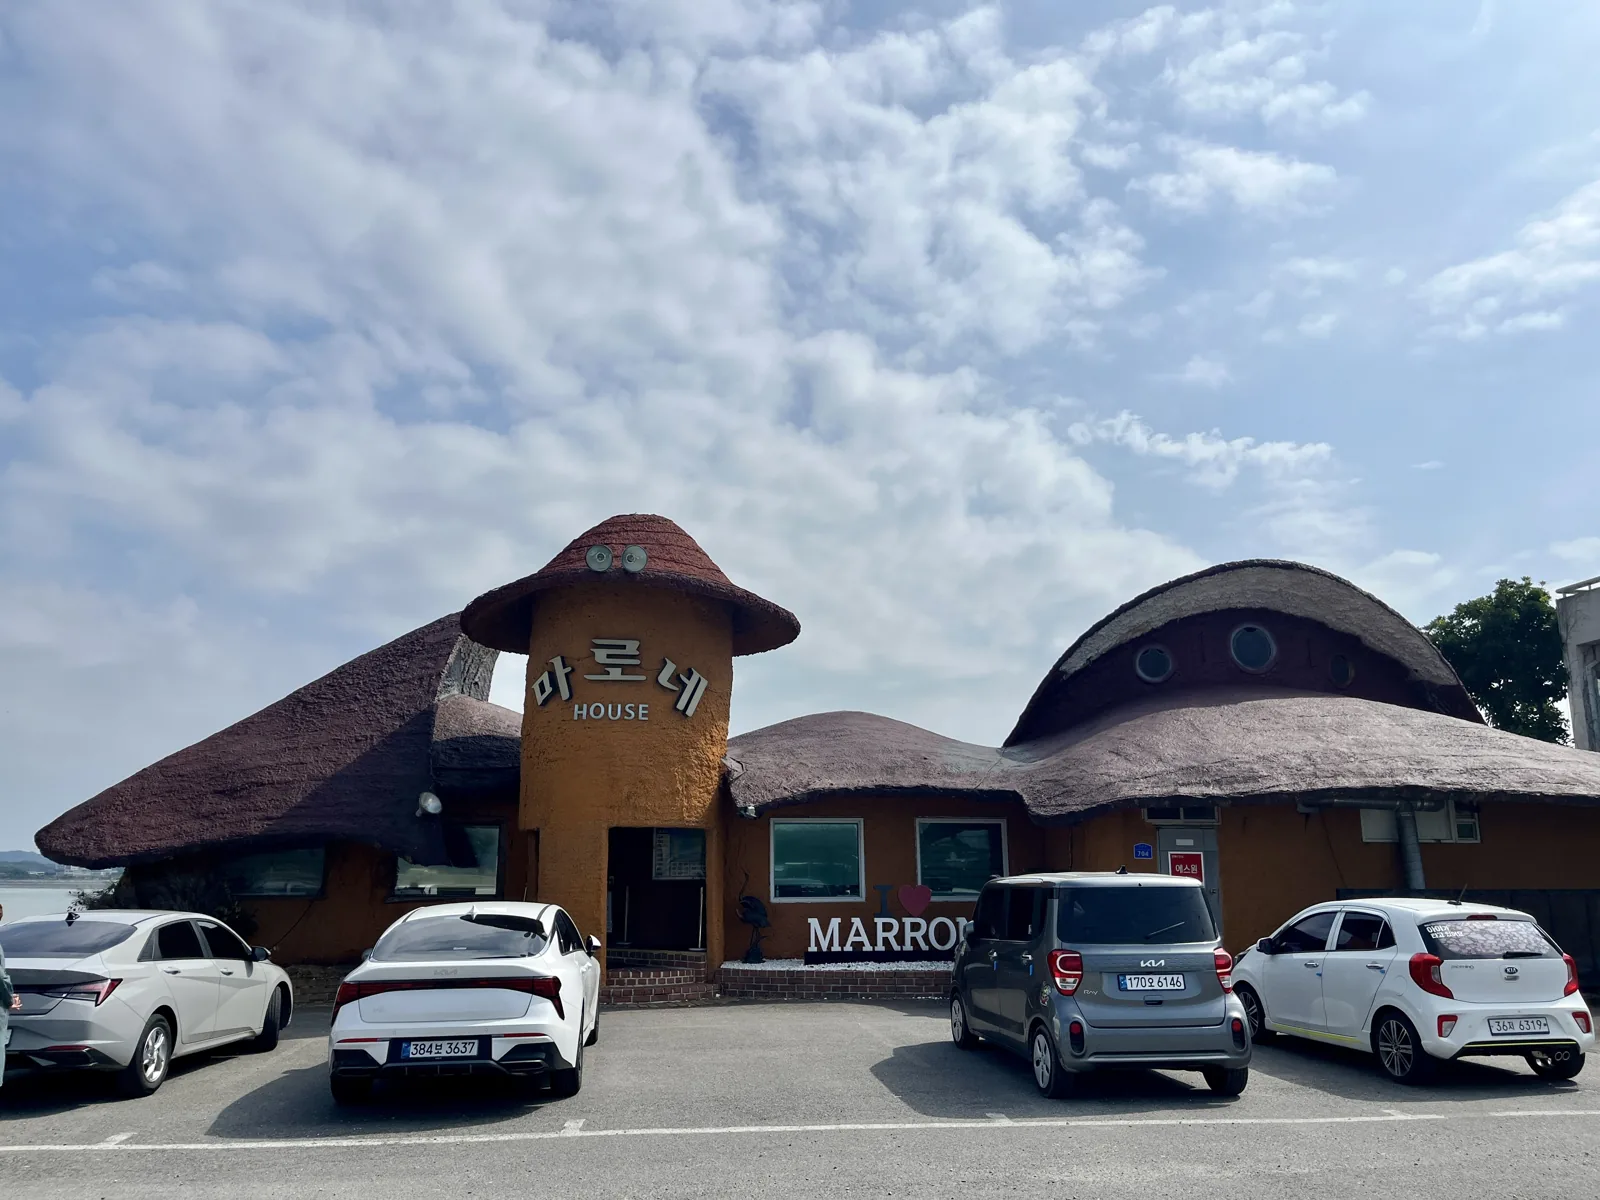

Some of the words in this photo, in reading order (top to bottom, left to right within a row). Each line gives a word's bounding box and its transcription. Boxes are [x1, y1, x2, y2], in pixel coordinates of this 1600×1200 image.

[531, 638, 709, 717] 마로네
[573, 702, 649, 721] HOUSE
[1175, 864, 1198, 874] 에스원
[873, 884, 895, 917] I
[1128, 976, 1154, 988] 170오
[1157, 976, 1182, 988] 6146
[1519, 1019, 1542, 1030] 6319
[411, 1042, 443, 1055] 384보
[445, 1041, 476, 1054] 3637
